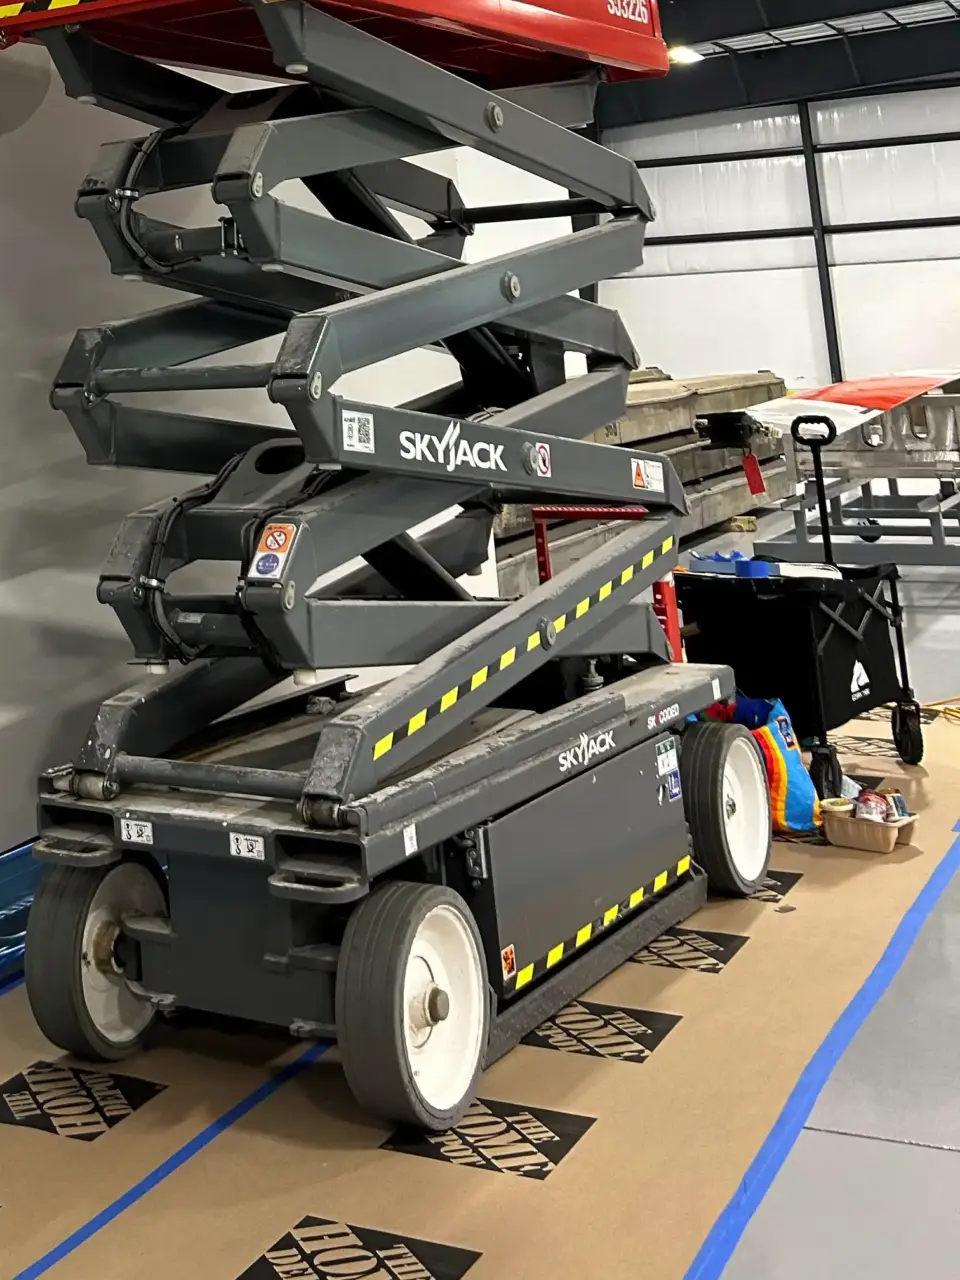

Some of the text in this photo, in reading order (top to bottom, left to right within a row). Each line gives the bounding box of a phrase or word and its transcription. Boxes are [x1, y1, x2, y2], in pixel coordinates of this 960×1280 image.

[399, 420, 508, 473] SKYJACK
[558, 729, 617, 772] SKYJACK
[648, 935, 725, 971] OME
[601, 1010, 653, 1035] THE
[3, 1090, 42, 1120] THE
[24, 1066, 110, 1137] HOME
[504, 1111, 561, 1144] THE
[426, 1130, 489, 1165] POT
